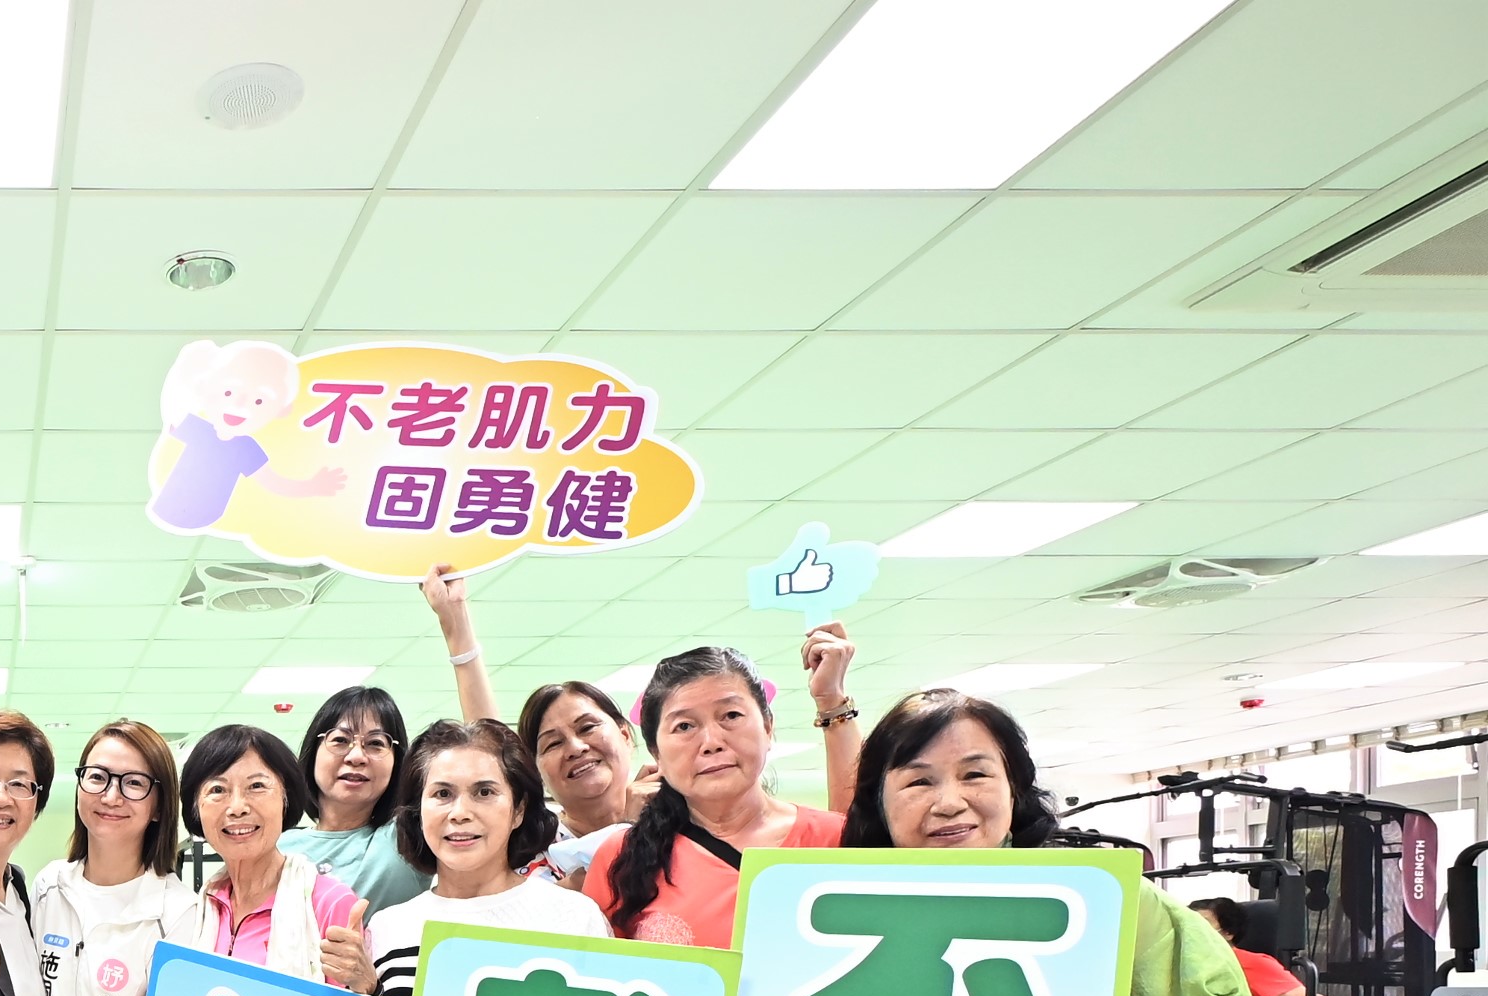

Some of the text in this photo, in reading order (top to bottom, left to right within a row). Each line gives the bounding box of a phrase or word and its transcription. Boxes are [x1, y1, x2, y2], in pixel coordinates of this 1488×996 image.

[303, 381, 646, 453] 不老肌力
[365, 466, 633, 541] 固勇健
[1413, 838, 1426, 900] CORENGTH
[101, 963, 124, 988] 妤
